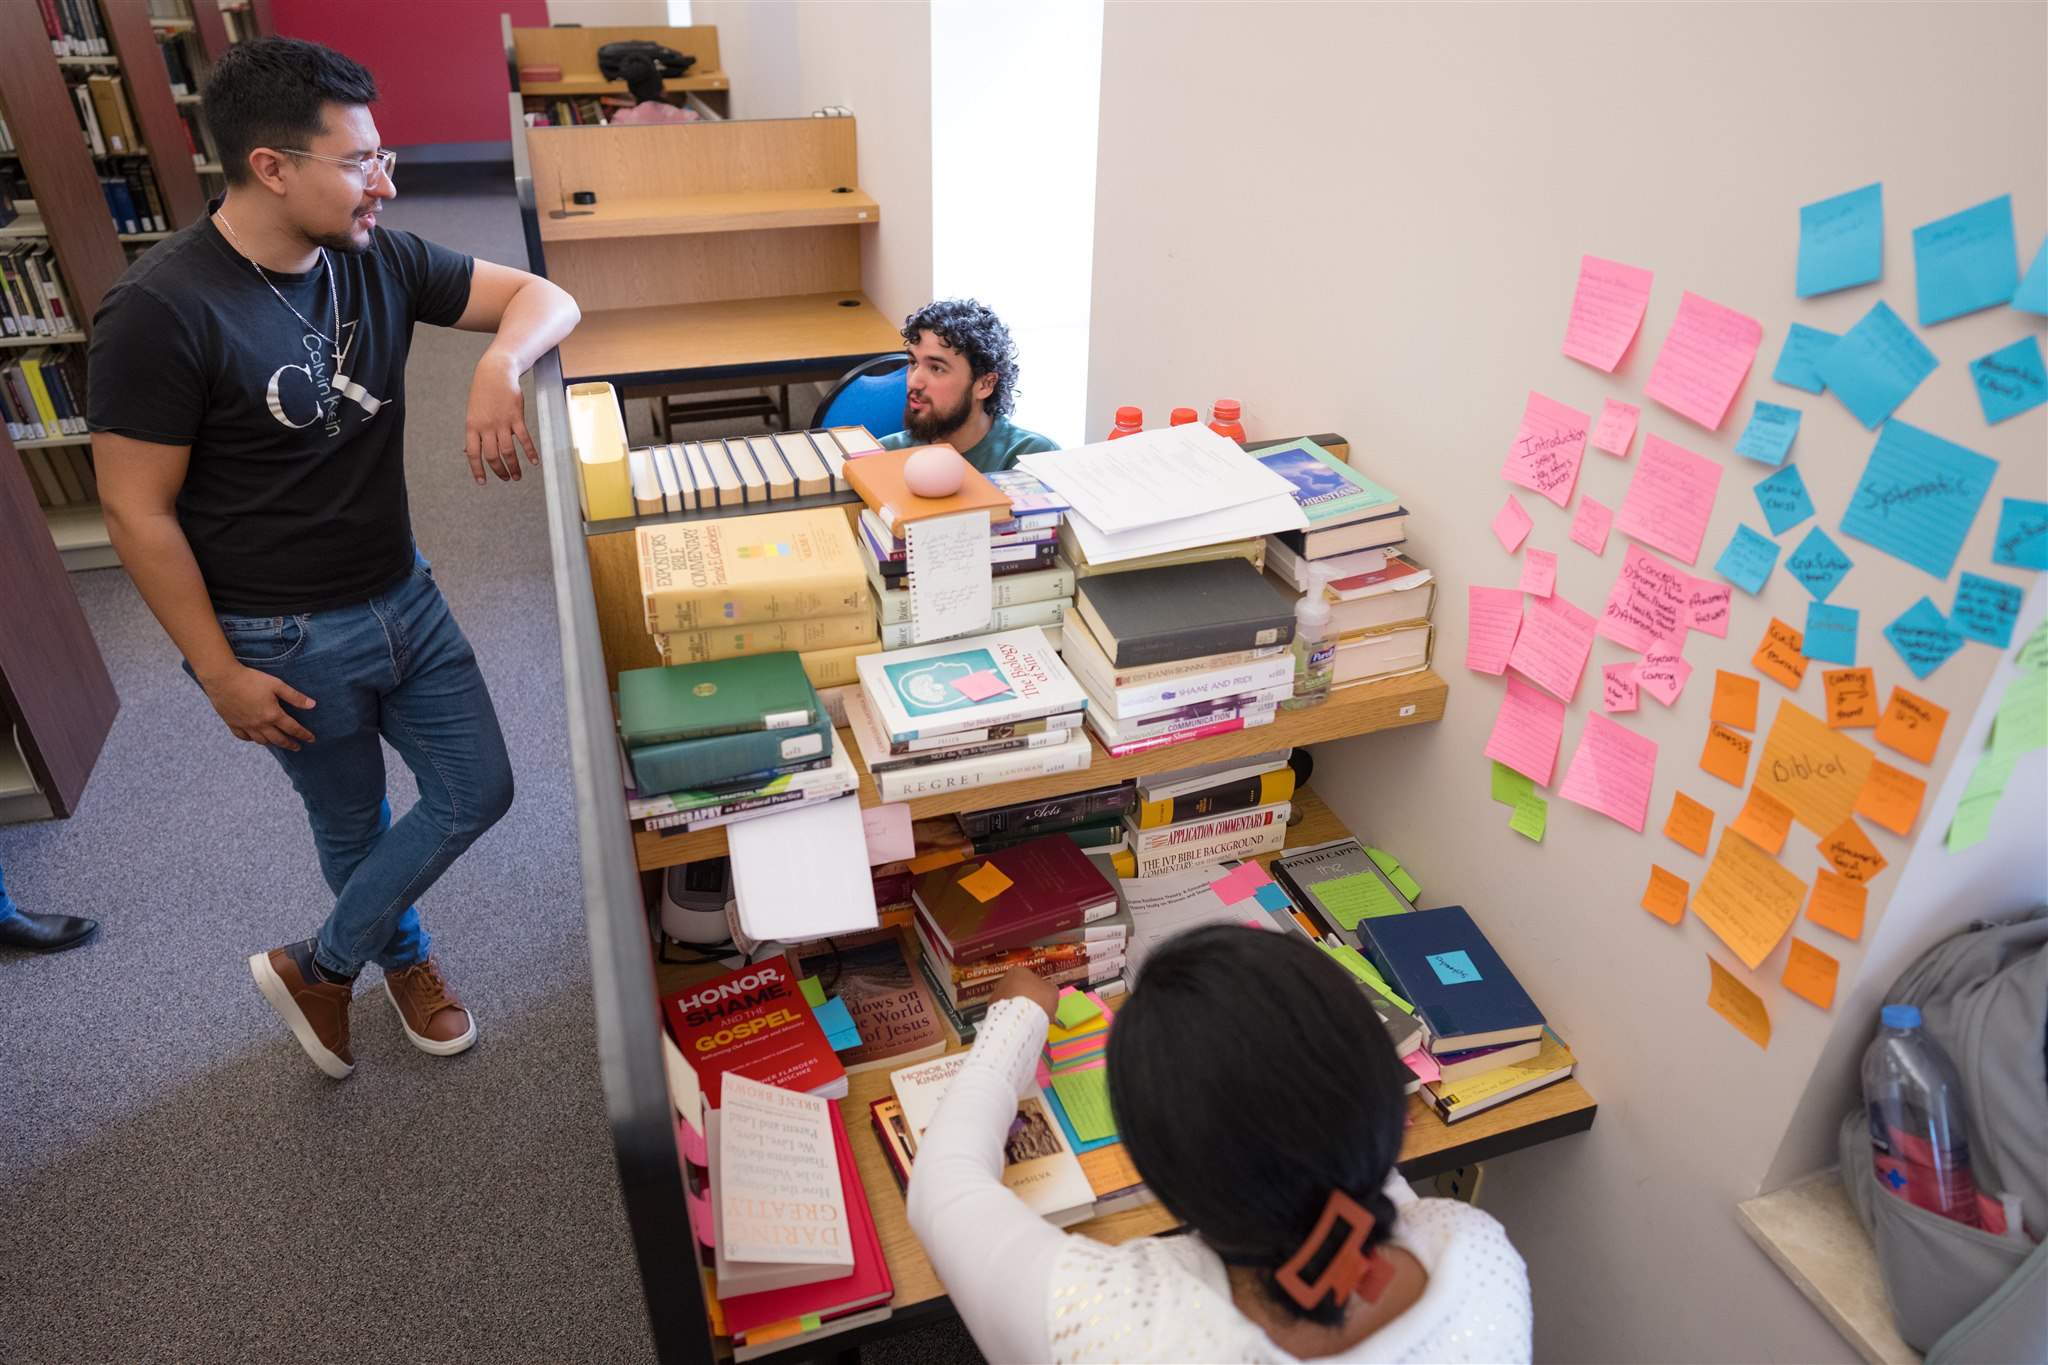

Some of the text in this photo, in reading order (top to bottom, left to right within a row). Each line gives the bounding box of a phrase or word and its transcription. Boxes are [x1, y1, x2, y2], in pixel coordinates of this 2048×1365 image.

[302, 333, 331, 397] Calvin
[1519, 429, 1586, 459] Introduction
[1864, 472, 1971, 519] Systematic
[669, 547, 688, 571] BIBLE
[683, 528, 709, 588] COMMENTARY
[1638, 557, 1682, 593] Concepts
[899, 600, 907, 621] Boice
[898, 626, 907, 648] Boice
[997, 643, 1041, 700] The Biology
[1023, 652, 1048, 683] of Sin:
[1178, 684, 1209, 697] SHAME
[1211, 679, 1232, 690] AND
[1233, 674, 1253, 686] PRIDE
[963, 712, 1022, 729] The Biology of Sin
[1167, 712, 1231, 732] COMMUNICATION
[930, 751, 946, 761] NOT
[946, 750, 956, 759] the
[903, 763, 1043, 795] REGRET LANDMAN
[1772, 754, 1847, 782] Biblical
[645, 805, 722, 832] ETHNOGRAPHY
[741, 798, 772, 810] Pastoral
[772, 792, 802, 804] Practice
[1026, 802, 1062, 821] Acts
[1167, 823, 1215, 846] APPLICATION
[1214, 812, 1265, 837] COMMENTARY
[1142, 834, 1264, 872] THE IVP BIBLE BACKGROUND
[1326, 845, 1361, 858] CAPPS
[1316, 862, 1345, 876] the
[1146, 902, 1160, 910] Study
[678, 968, 785, 1013] HONOR,
[686, 983, 793, 1027] SHAME,
[851, 990, 919, 1016] dows on
[873, 1000, 925, 1029] World
[721, 1006, 766, 1027] AND THE
[695, 1008, 802, 1051] GOSPEL
[700, 1021, 805, 1061] Reframing Our Message and Ministry
[865, 1026, 882, 1043] of
[882, 1016, 931, 1041] Jesus
[777, 1067, 812, 1084] MISCHKE
[778, 1058, 818, 1077] FLANDERS
[724, 1080, 773, 1102] BROWN
[760, 1119, 780, 1131] and
[783, 1124, 819, 1140] Parent
[748, 1148, 765, 1161] the
[799, 1142, 816, 1154] We
[767, 1152, 829, 1168] Transforms
[794, 1170, 808, 1182] be
[811, 1171, 824, 1180] to
[781, 1185, 831, 1198] How the
[726, 1196, 838, 1221] GREATLY
[729, 1222, 840, 1247] DARING
